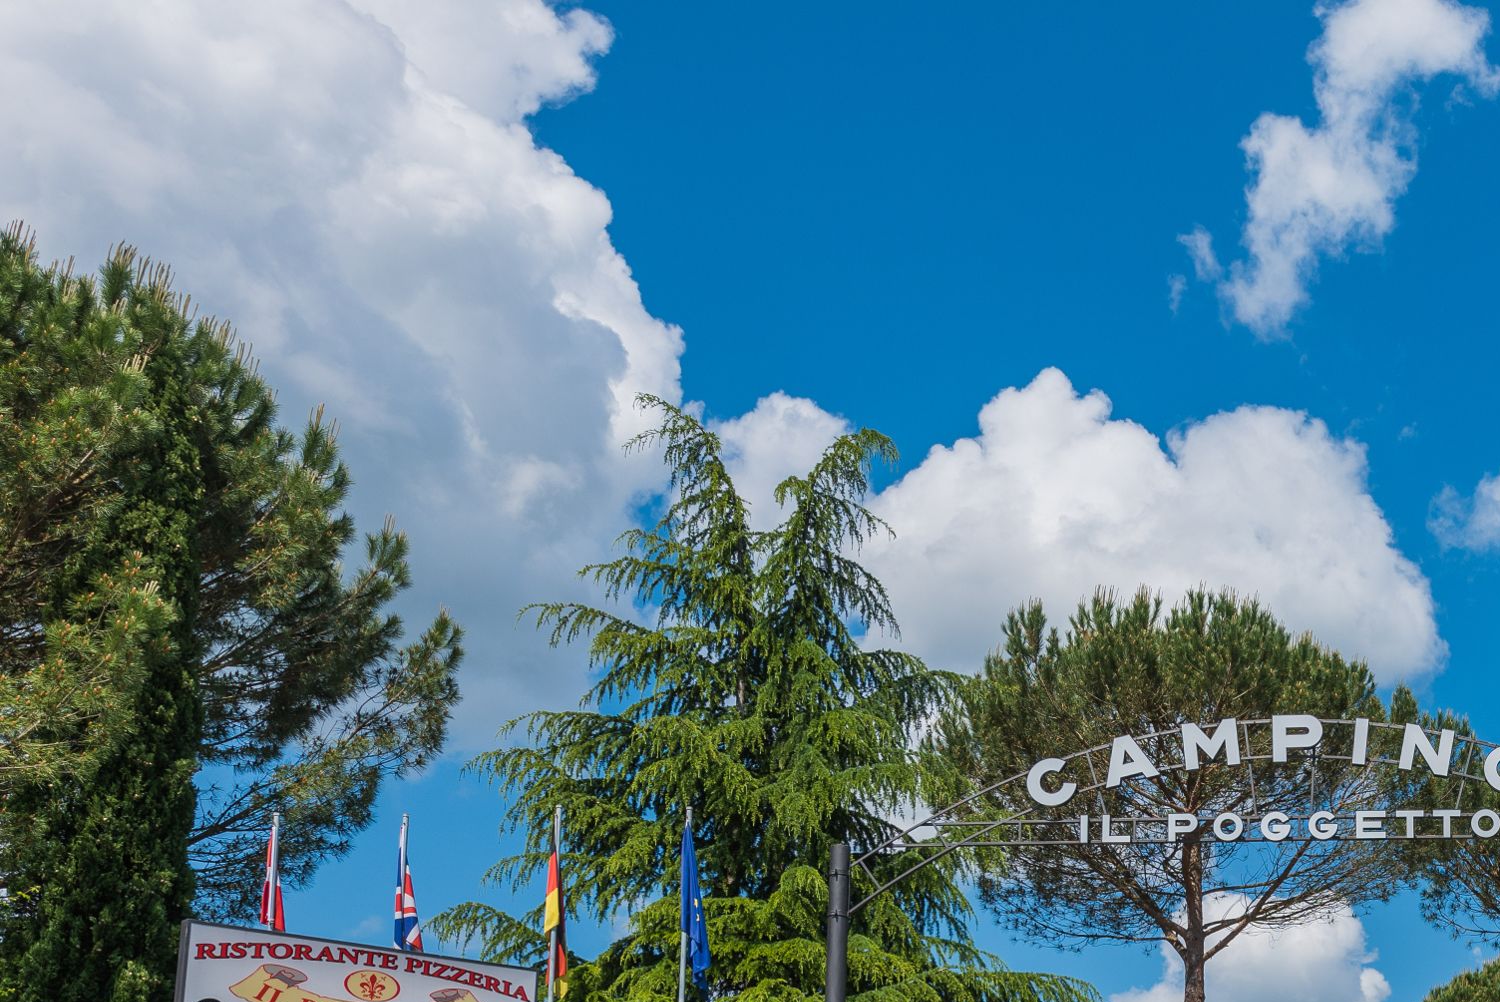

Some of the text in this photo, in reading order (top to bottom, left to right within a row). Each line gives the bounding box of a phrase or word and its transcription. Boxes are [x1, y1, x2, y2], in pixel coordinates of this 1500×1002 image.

[1079, 808, 1500, 844] IL POGGETTO
[194, 942, 530, 1002] RISTORANTE PIZZERIA
